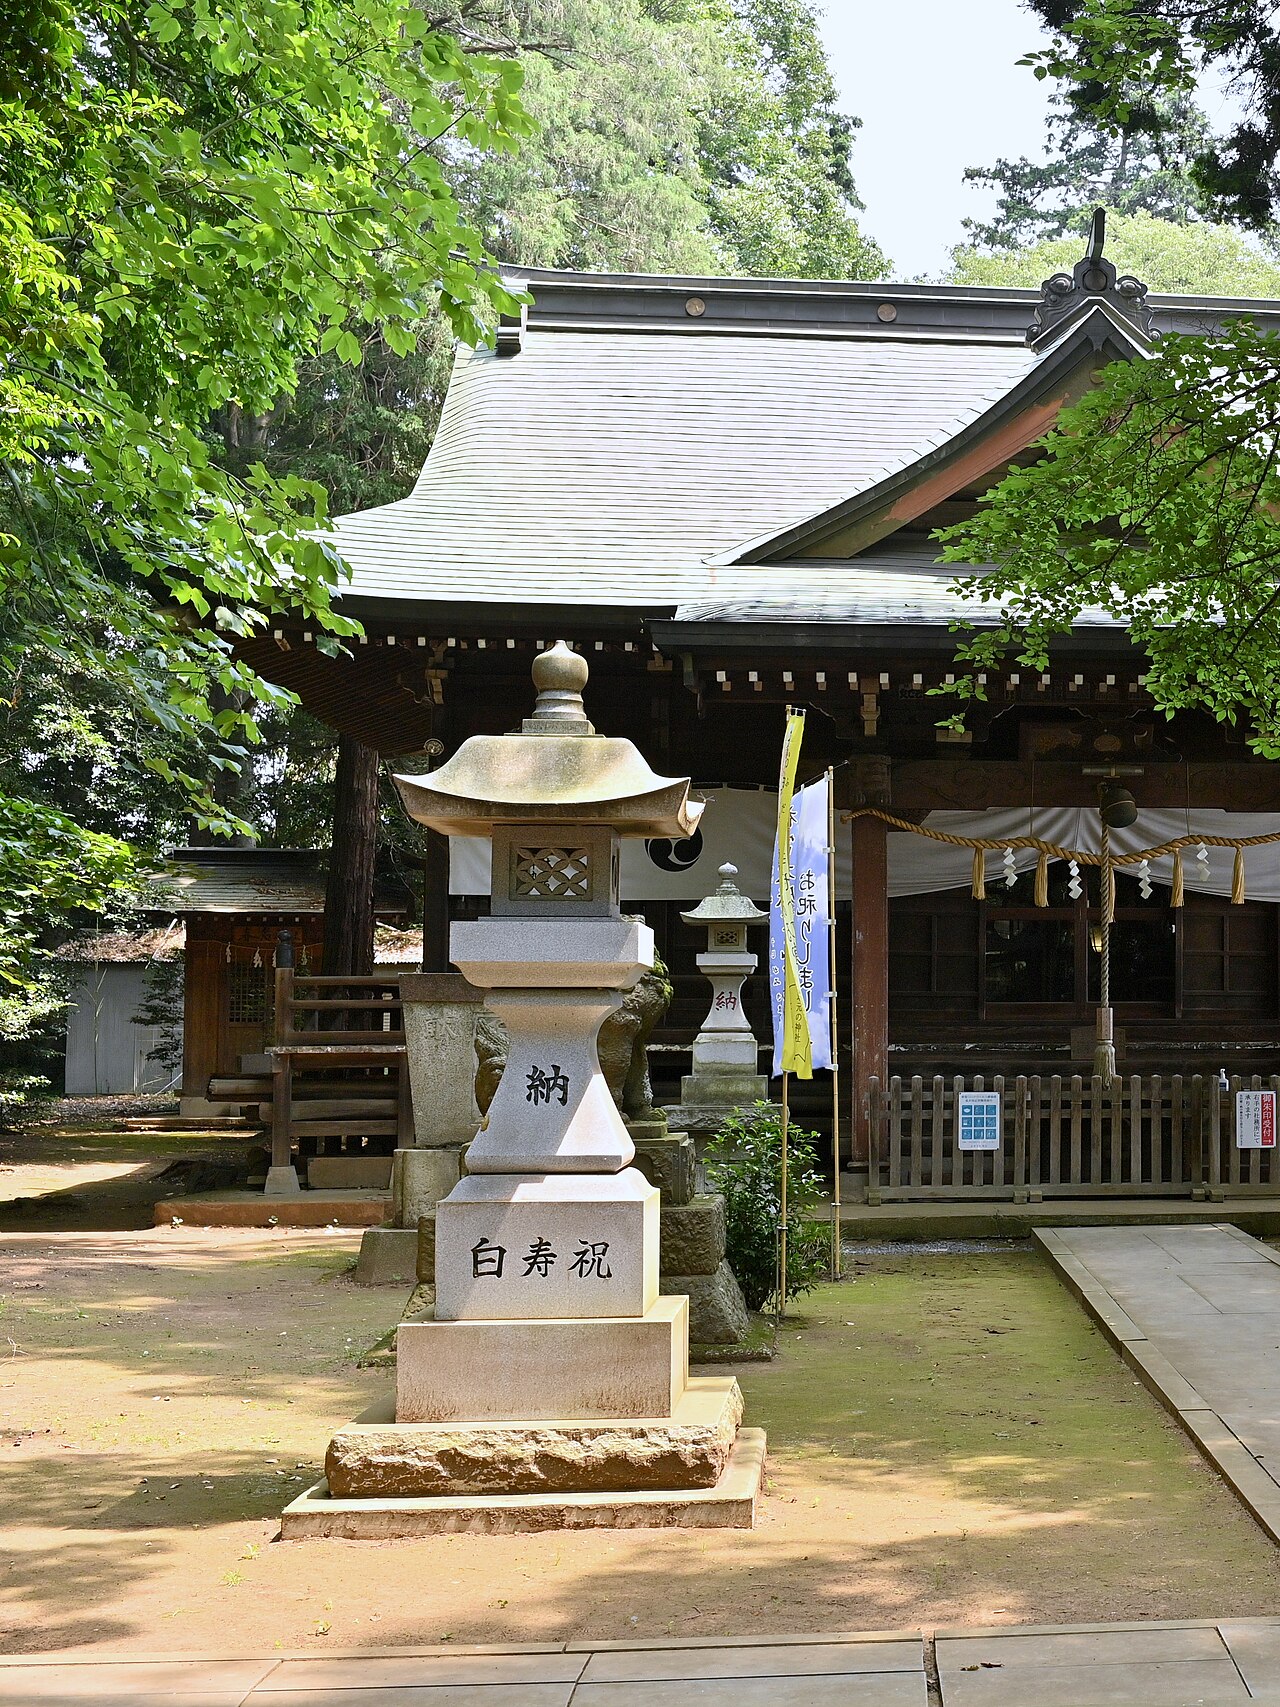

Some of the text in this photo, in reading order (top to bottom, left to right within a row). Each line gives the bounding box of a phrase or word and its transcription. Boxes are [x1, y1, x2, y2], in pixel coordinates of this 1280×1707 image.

[715, 990, 738, 1012] 納
[524, 1064, 570, 1107] 納
[1262, 1094, 1272, 1137] 御朱印受付
[471, 1236, 613, 1280] 白寿祝
